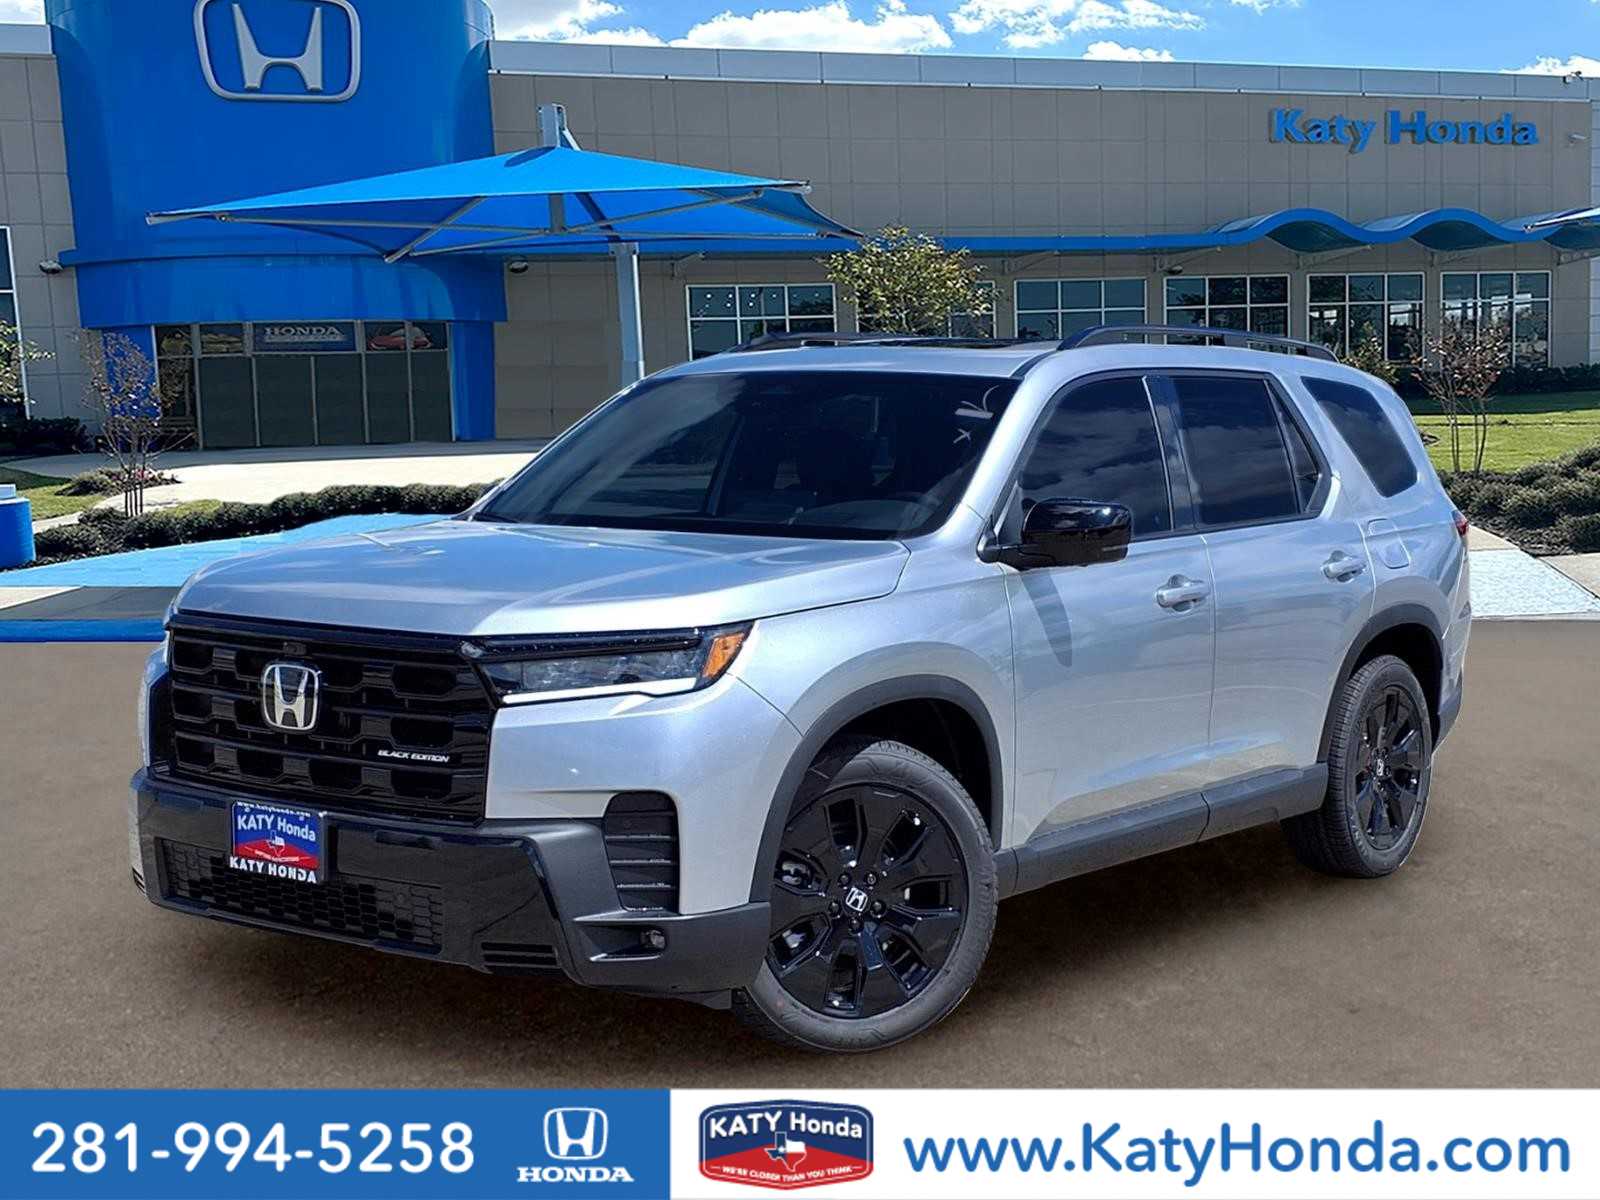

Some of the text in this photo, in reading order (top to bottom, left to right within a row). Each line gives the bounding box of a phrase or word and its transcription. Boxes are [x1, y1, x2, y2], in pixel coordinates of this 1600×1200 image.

[1269, 107, 1539, 154] Katy Honda
[264, 326, 344, 336] HONDA
[377, 749, 450, 763] BLACK EDITION
[237, 813, 317, 843] KATY Honda
[229, 855, 265, 874] KATY
[268, 862, 317, 885] HONDA
